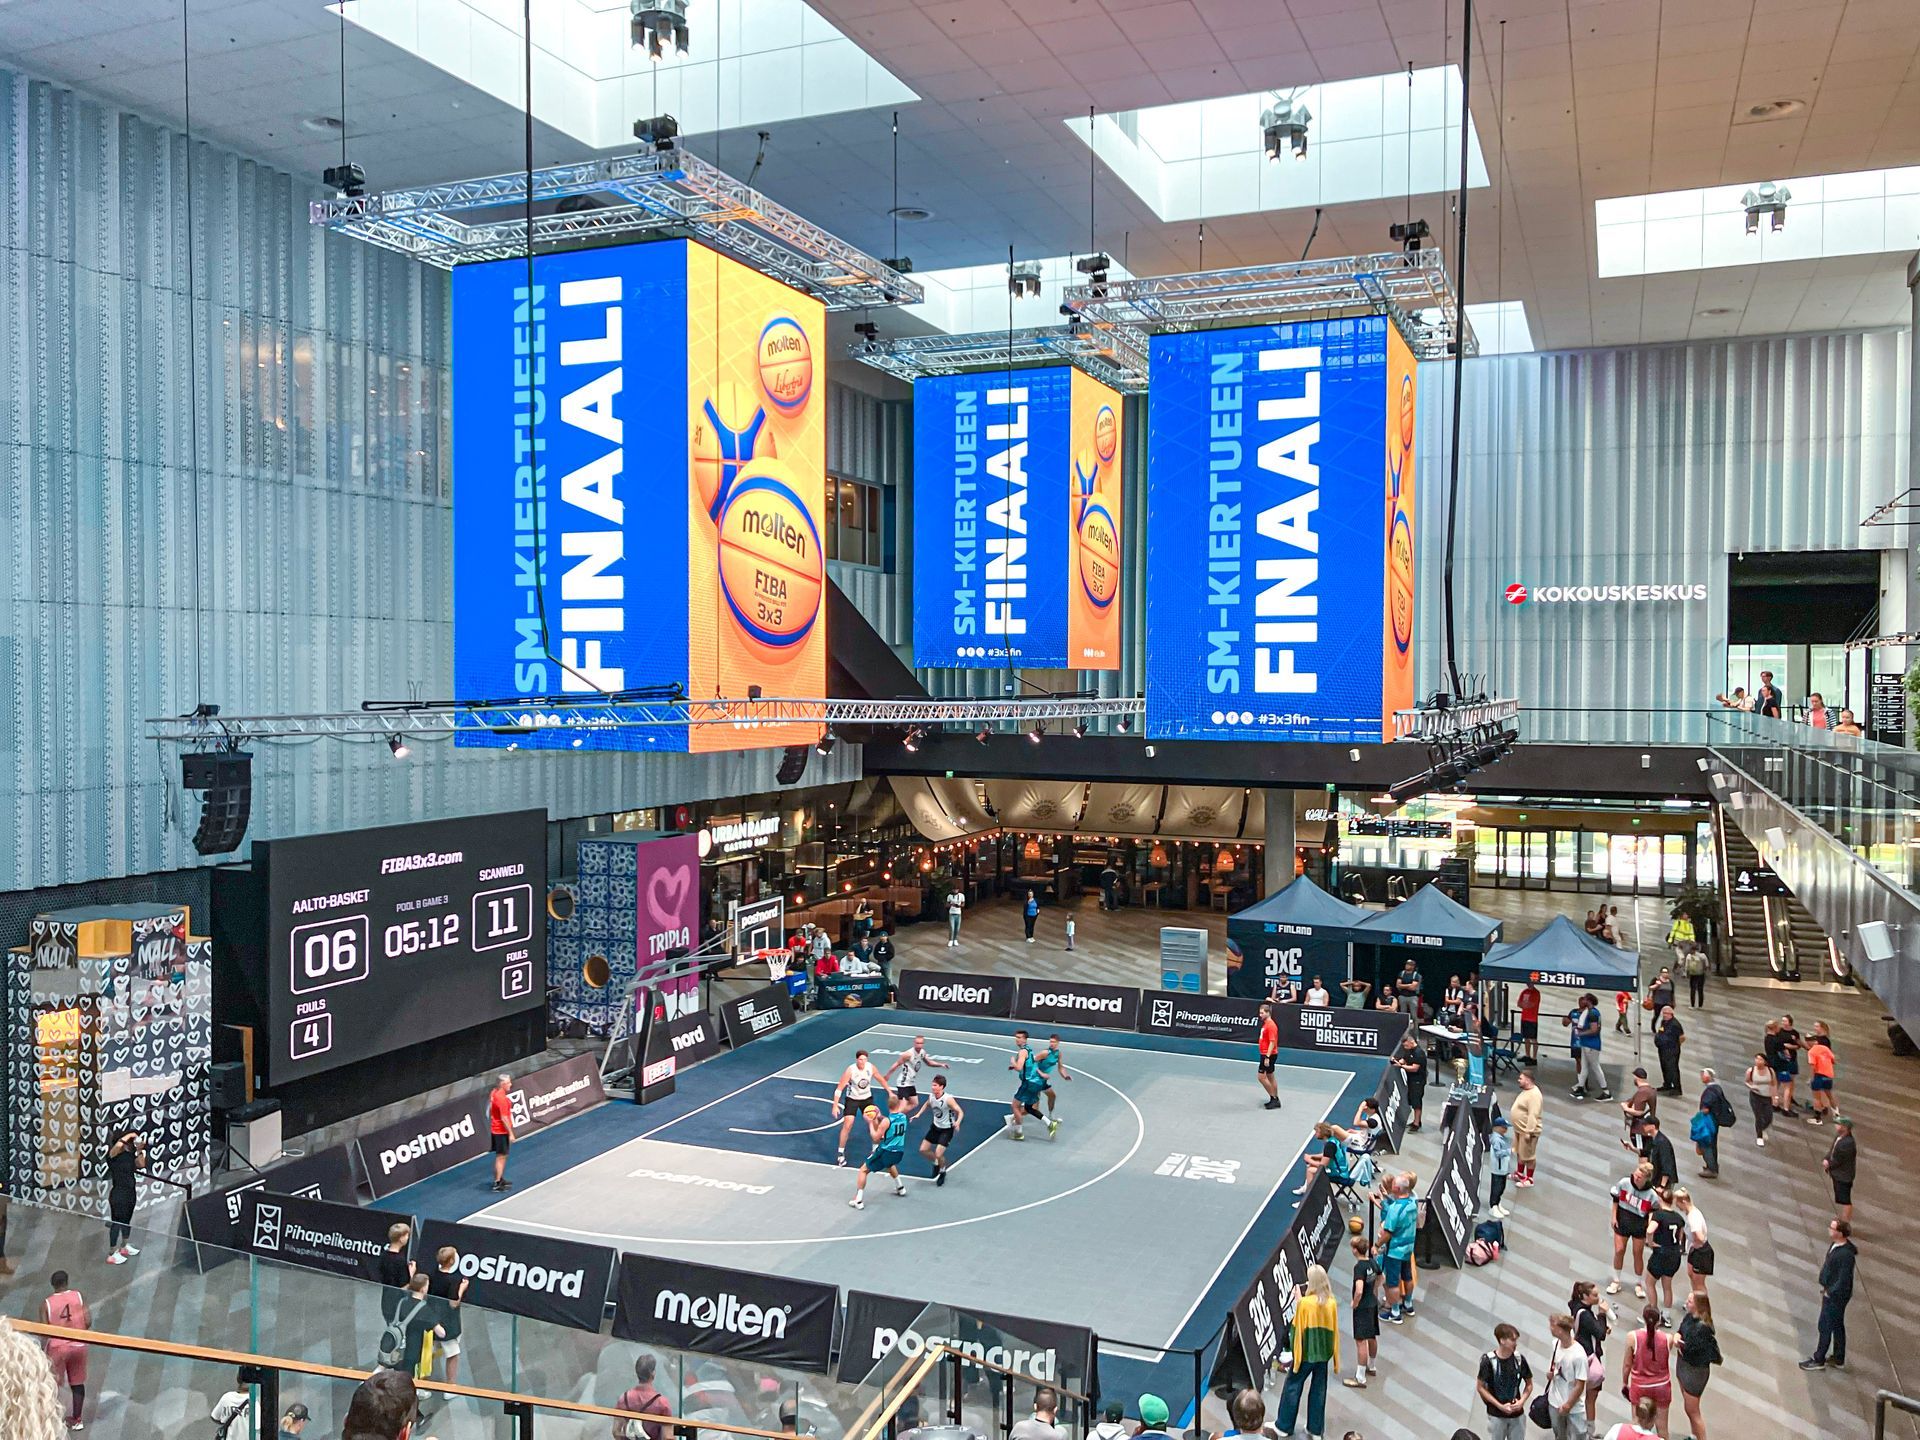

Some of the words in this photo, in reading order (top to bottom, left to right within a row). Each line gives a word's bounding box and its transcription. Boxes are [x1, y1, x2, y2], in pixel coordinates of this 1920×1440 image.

[768, 336, 801, 356] molten
[514, 284, 547, 694] SM-KIERTUEEN
[560, 276, 624, 692] FINAALI
[954, 391, 977, 636] SM-KIERTUEEN
[986, 386, 1028, 635] FINAALI
[1254, 346, 1322, 694] FINAALI
[1206, 351, 1244, 694] SM-KIERTUEEN
[743, 510, 806, 559] molten
[756, 569, 787, 599] FIBA
[1532, 584, 1706, 602] KOKOUSKESKUS
[758, 602, 783, 625] 3x3
[1258, 713, 1311, 725] #3x3fin
[381, 852, 462, 874] FIBA3x3.com
[479, 864, 524, 881] SCANWELD
[1738, 870, 1750, 884] 4
[292, 889, 370, 914] AALTO-BASKET
[396, 900, 414, 912] POOL
[422, 896, 443, 908] GAME
[488, 897, 518, 938] 11
[742, 906, 778, 930] postnord
[385, 914, 460, 958] 05:12
[649, 926, 690, 956] TRIPLA
[1278, 924, 1312, 936] FINLAND
[1406, 935, 1442, 946] FINLAND
[304, 928, 357, 978] 06
[506, 949, 528, 962] FOULS
[512, 970, 522, 991] 2
[1530, 972, 1585, 986] #3x3fin
[918, 984, 990, 1004] molten
[1032, 991, 1122, 1014] postnord
[297, 999, 326, 1016] FOULS
[1176, 1010, 1259, 1027] Pihapelikentta.fi
[1300, 1012, 1334, 1029] SHOP.
[304, 1022, 319, 1046] 4
[1316, 1030, 1378, 1047] BASKET.FI
[378, 1114, 476, 1174] postnord
[627, 1168, 774, 1195] postnord
[284, 1224, 390, 1256] Pihapelikentta
[1669, 1224, 1678, 1244] 7
[60, 1304, 72, 1322] 4
[654, 1289, 785, 1340] molten
